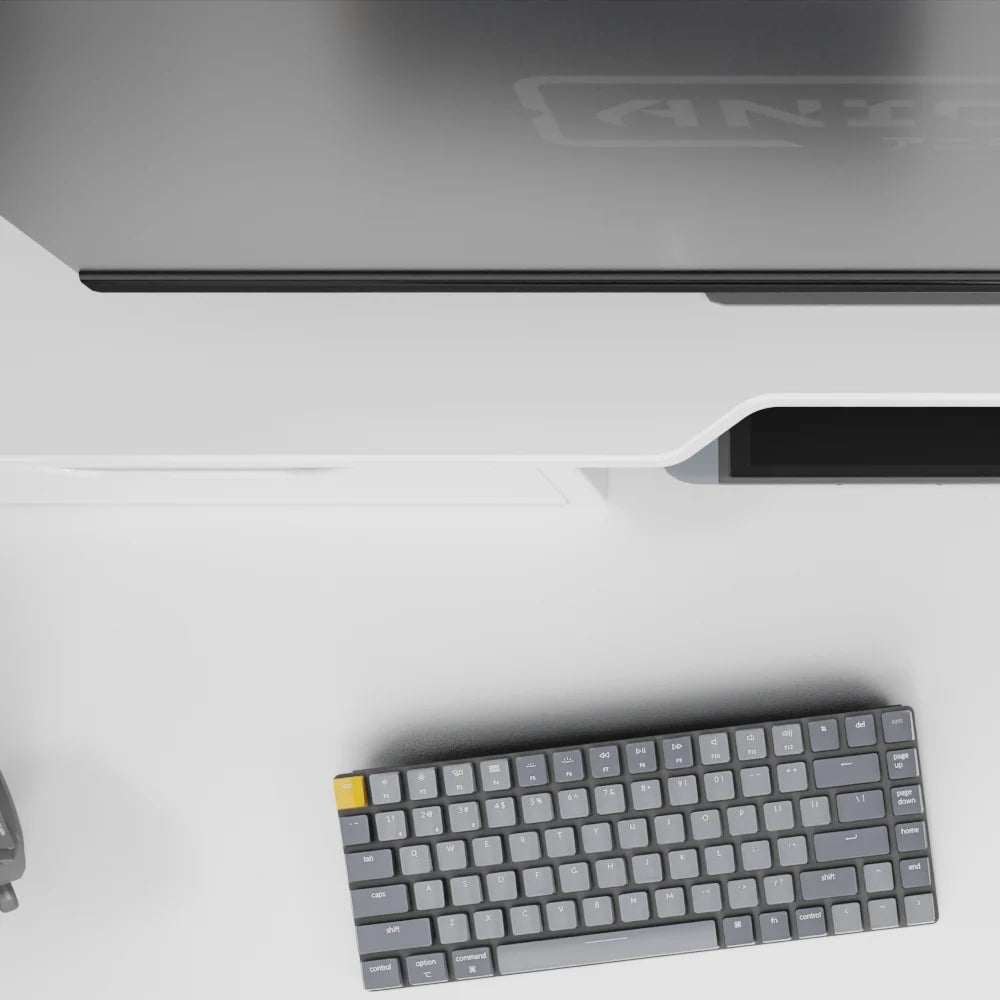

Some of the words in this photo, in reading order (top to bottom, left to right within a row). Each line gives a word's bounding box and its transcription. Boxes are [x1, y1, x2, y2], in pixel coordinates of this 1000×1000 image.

[893, 753, 909, 761] page
[896, 789, 912, 797] page
[898, 797, 916, 805] down
[901, 827, 919, 835] home
[363, 855, 374, 863] tab
[908, 863, 921, 871] end
[821, 873, 835, 881] shift
[799, 911, 822, 921] control
[386, 926, 400, 934] shift
[456, 952, 487, 962] command
[416, 959, 436, 967] option
[370, 964, 392, 973] control
